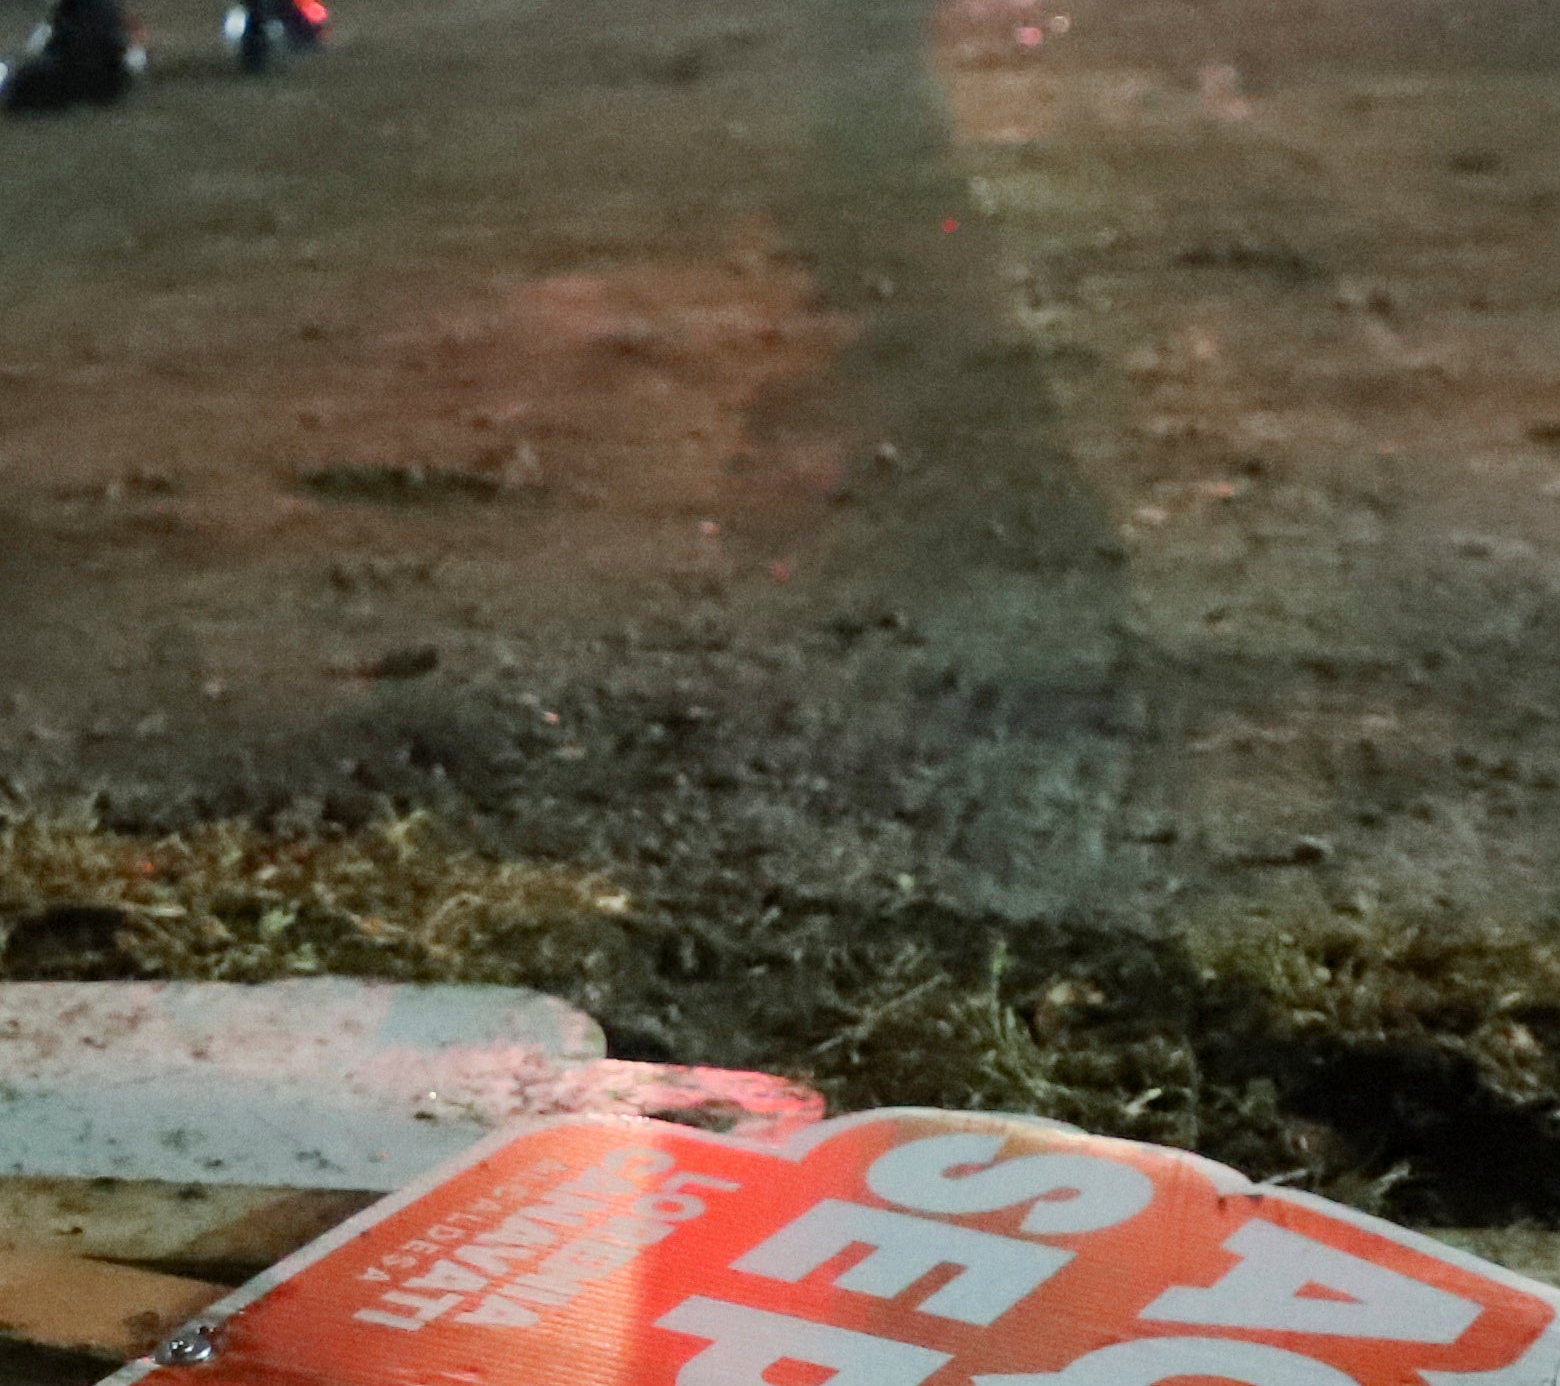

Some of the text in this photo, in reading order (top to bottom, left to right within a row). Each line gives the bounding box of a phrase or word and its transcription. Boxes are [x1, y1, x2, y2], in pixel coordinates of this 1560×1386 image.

[352, 1146, 676, 1332] CANAVATI
[453, 1170, 742, 1327] LORENIA
[726, 1131, 1155, 1327] SE
